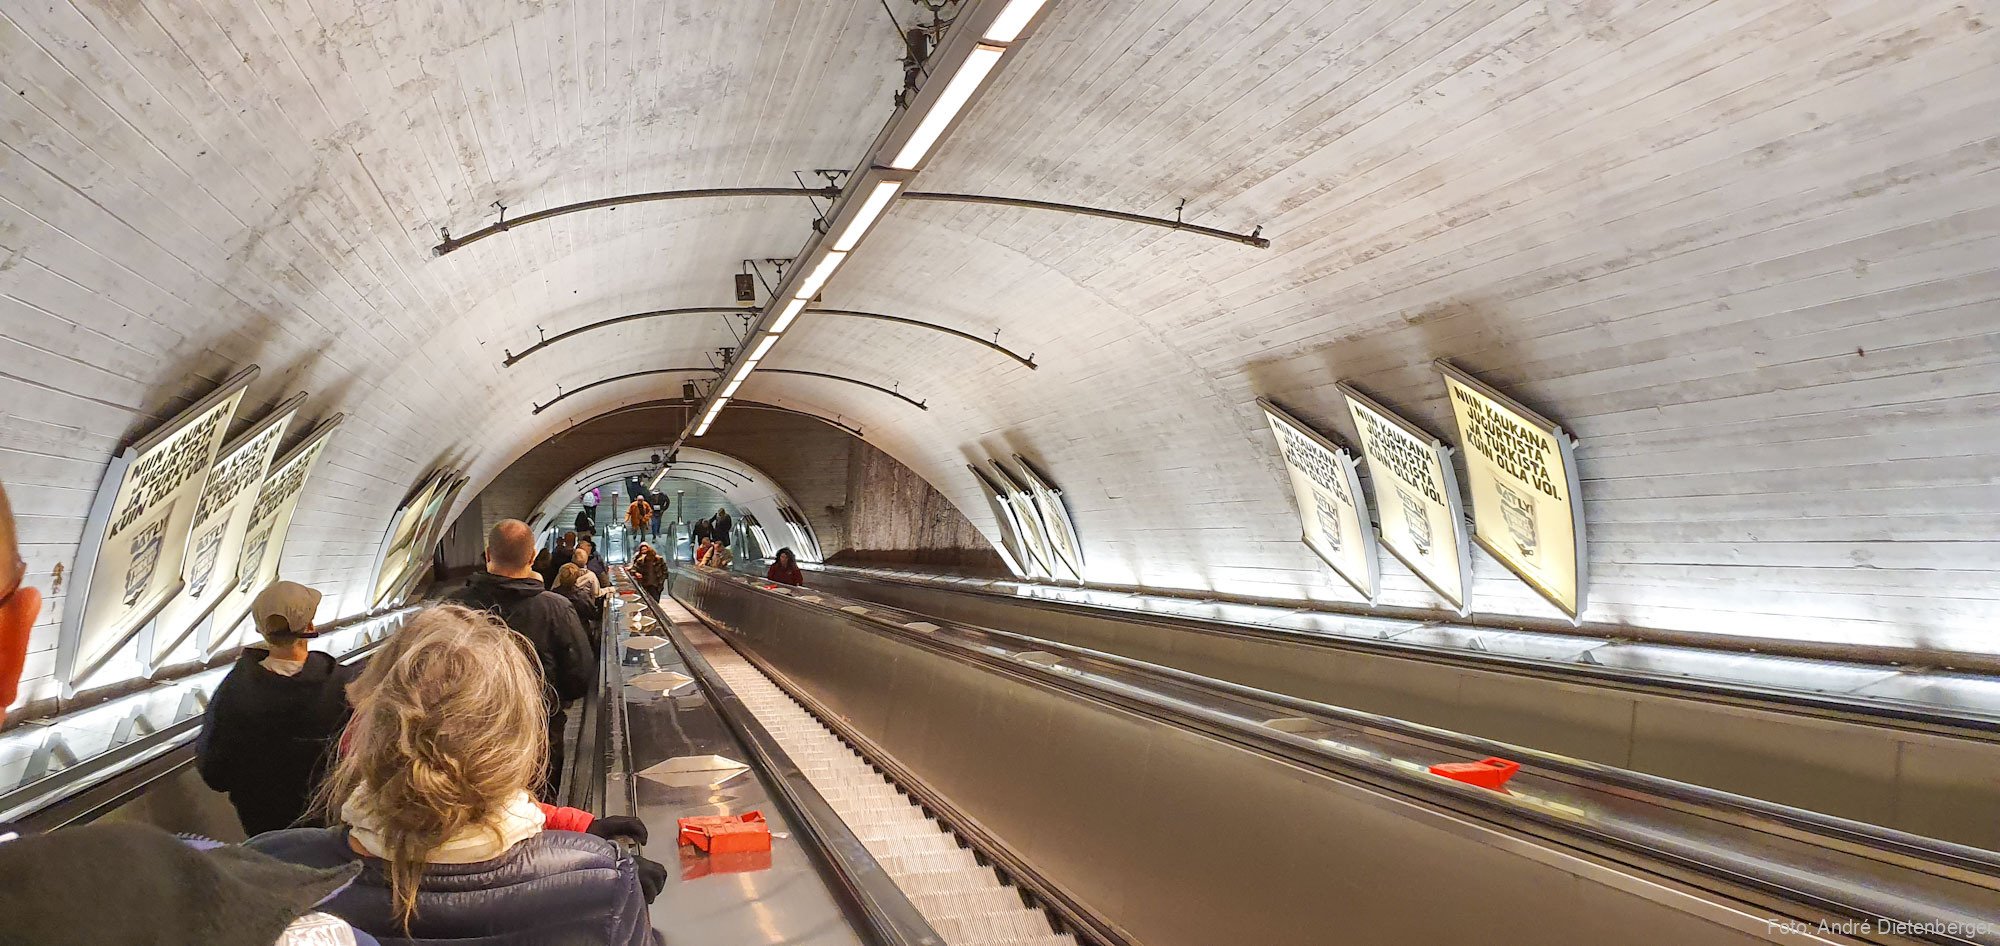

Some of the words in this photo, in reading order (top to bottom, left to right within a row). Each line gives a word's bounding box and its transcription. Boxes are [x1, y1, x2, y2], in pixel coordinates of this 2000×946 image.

[130, 447, 168, 483] NIIN
[168, 401, 231, 456] KAUKANA
[1355, 405, 1378, 429] NIIN
[1380, 422, 1434, 465] KAUKANA
[1367, 424, 1430, 474] JUGURTISTA
[1454, 386, 1482, 413] NIIN
[1485, 404, 1551, 455] KAUKANA
[1466, 408, 1545, 465] JUGURTISTA
[1469, 421, 1482, 437] JA
[1484, 430, 1551, 482] TURKISTA
[122, 491, 142, 516] JA
[147, 441, 211, 497] TURKISTA
[132, 424, 217, 495] JUGURTISTA
[1367, 443, 1392, 471] KUIN
[1394, 464, 1420, 492] OLLA
[1421, 483, 1445, 507] VOI.
[1369, 435, 1380, 450] JA
[1381, 445, 1436, 490] TURKISTA
[1466, 429, 1494, 461] KUIN
[1497, 454, 1529, 484] OLLA
[1532, 474, 1562, 501] VOI.
[109, 500, 149, 540] KUIN
[149, 473, 184, 508] OLLA
